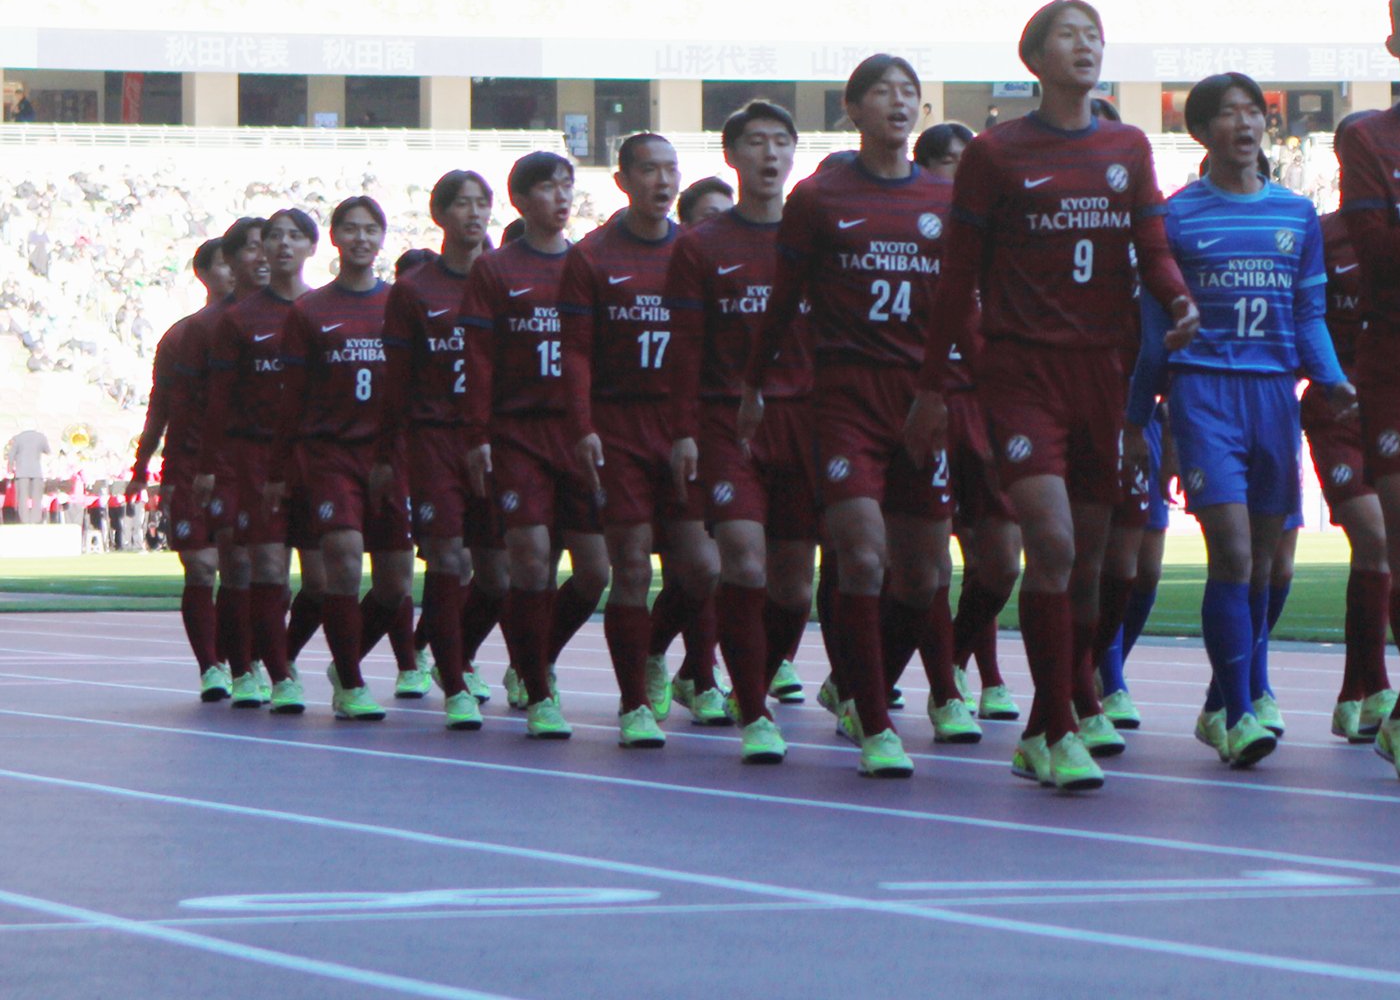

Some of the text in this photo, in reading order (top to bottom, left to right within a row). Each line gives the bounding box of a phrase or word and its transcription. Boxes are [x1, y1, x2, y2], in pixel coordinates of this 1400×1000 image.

[165, 35, 417, 72] 秋田代表 秋田商
[654, 44, 778, 76] 山形代表
[1153, 46, 1276, 78] 宮城代表
[1060, 197, 1109, 211] KYOTO
[1026, 211, 1131, 231] TACHIBANA
[839, 253, 941, 274] TACHIBANA
[869, 241, 918, 254] KYOTO
[1073, 239, 1093, 283] 9
[1199, 271, 1293, 288] TACHIBANA
[1228, 259, 1274, 271] KYOTO
[868, 279, 912, 323] 24
[1233, 297, 1268, 338] 12
[637, 331, 671, 368] 17
[355, 368, 372, 401] 8
